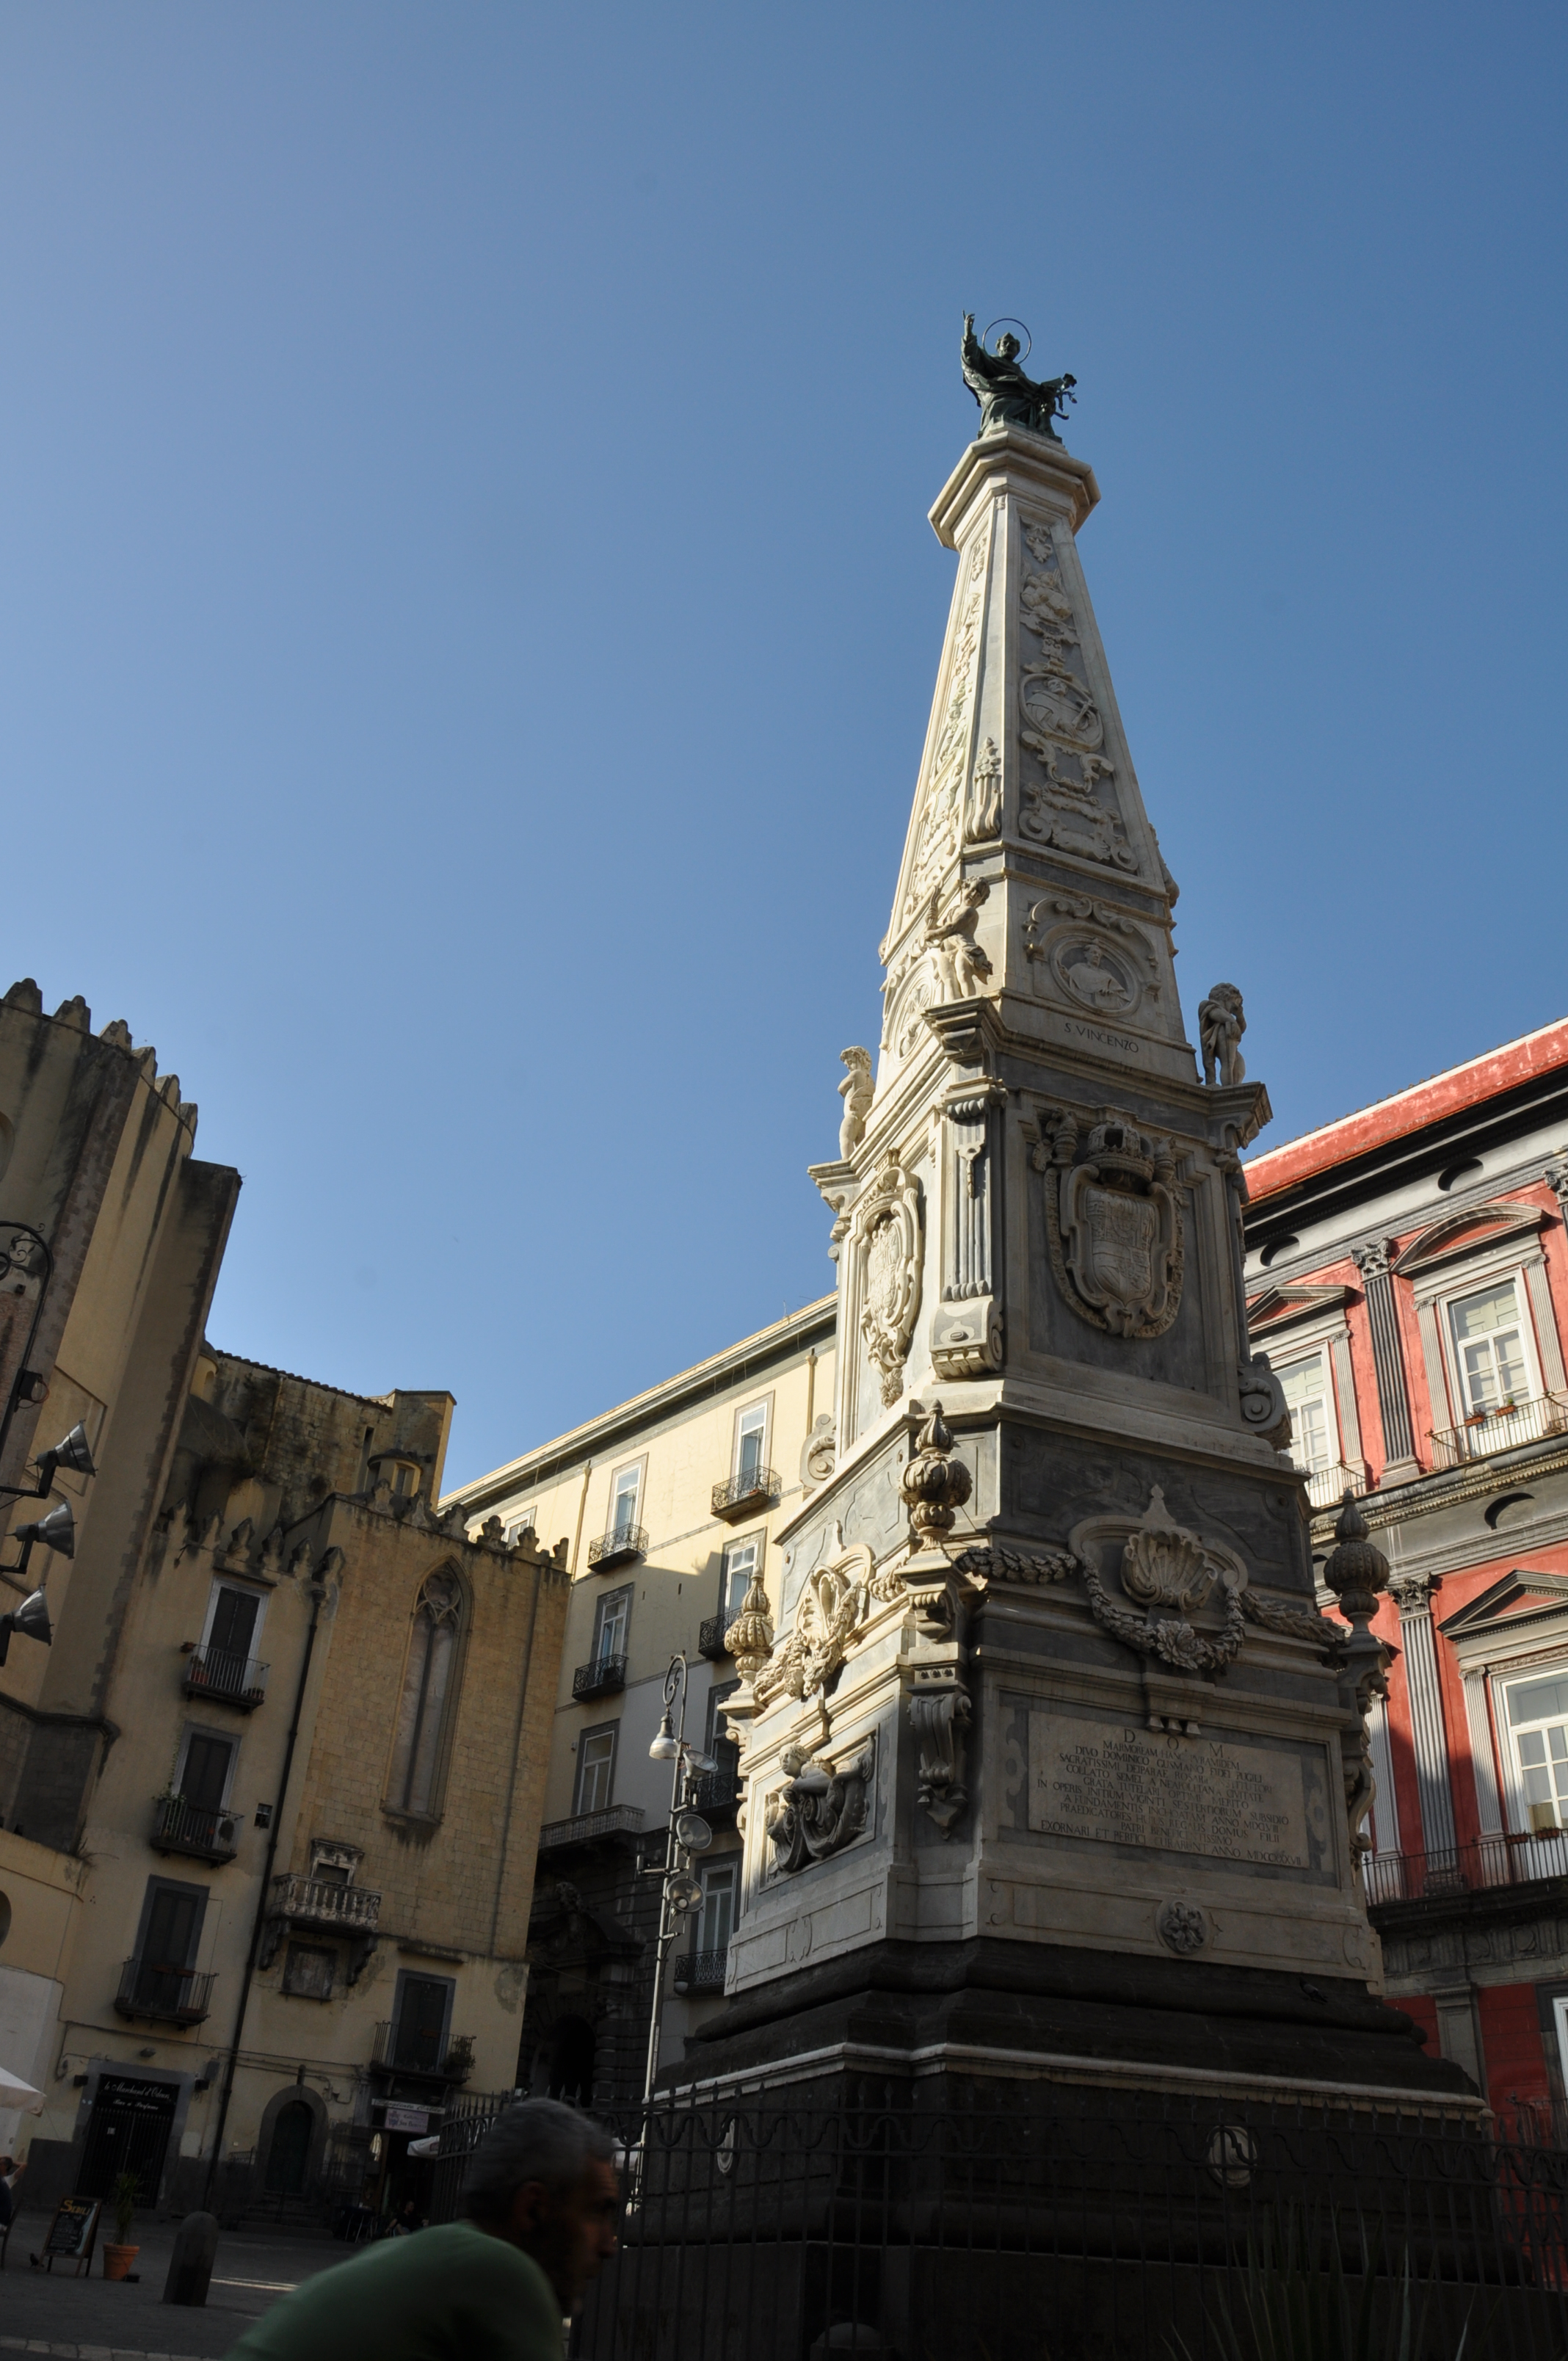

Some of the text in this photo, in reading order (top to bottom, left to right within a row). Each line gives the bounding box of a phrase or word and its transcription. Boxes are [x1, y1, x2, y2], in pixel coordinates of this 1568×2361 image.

[1075, 1025, 1139, 1053] VINCENZO
[1059, 1752, 1120, 1771] SACRATISSIMI
[1126, 1763, 1169, 1778] DEIPARAE
[1075, 1745, 1263, 1784] DIVO DOMINICO GUSMANO FIDEI PUGILI
[1103, 1740, 1158, 1758] MARMOREAM
[1066, 1764, 1264, 1803] COLLATO SEMEL A NEAPOLITANA CIVITATE
[1083, 1777, 1114, 1789] GRATA
[1119, 1782, 1160, 1796] TUTELARI
[1212, 1796, 1249, 1810] MERITO
[1037, 1779, 1290, 1825] IN OPERIS INITIUM VIGINTI SESTERTIORUM SUBSIDIO
[1064, 1794, 1072, 1803] A
[1075, 1795, 1143, 1813] FUNDAMENTIS
[1149, 1806, 1206, 1823] INCHOATAM
[1211, 1816, 1240, 1828] ANNO
[1041, 1819, 1089, 1837] EXORNARI
[1095, 1828, 1109, 1840] ET
[1114, 1830, 1147, 1845] PERFICI
[1154, 1836, 1208, 1854] CURARUNT
[1211, 1845, 1241, 1858] ANNO
[1060, 1802, 1132, 1821] PRAEDICATORES
[1169, 1819, 1206, 1832] REGALIS
[1211, 1825, 1249, 1839] DOMUS
[1260, 1832, 1280, 1843] FILII
[1121, 1822, 1233, 1846] PATRI BENEFICENTISSIMO
